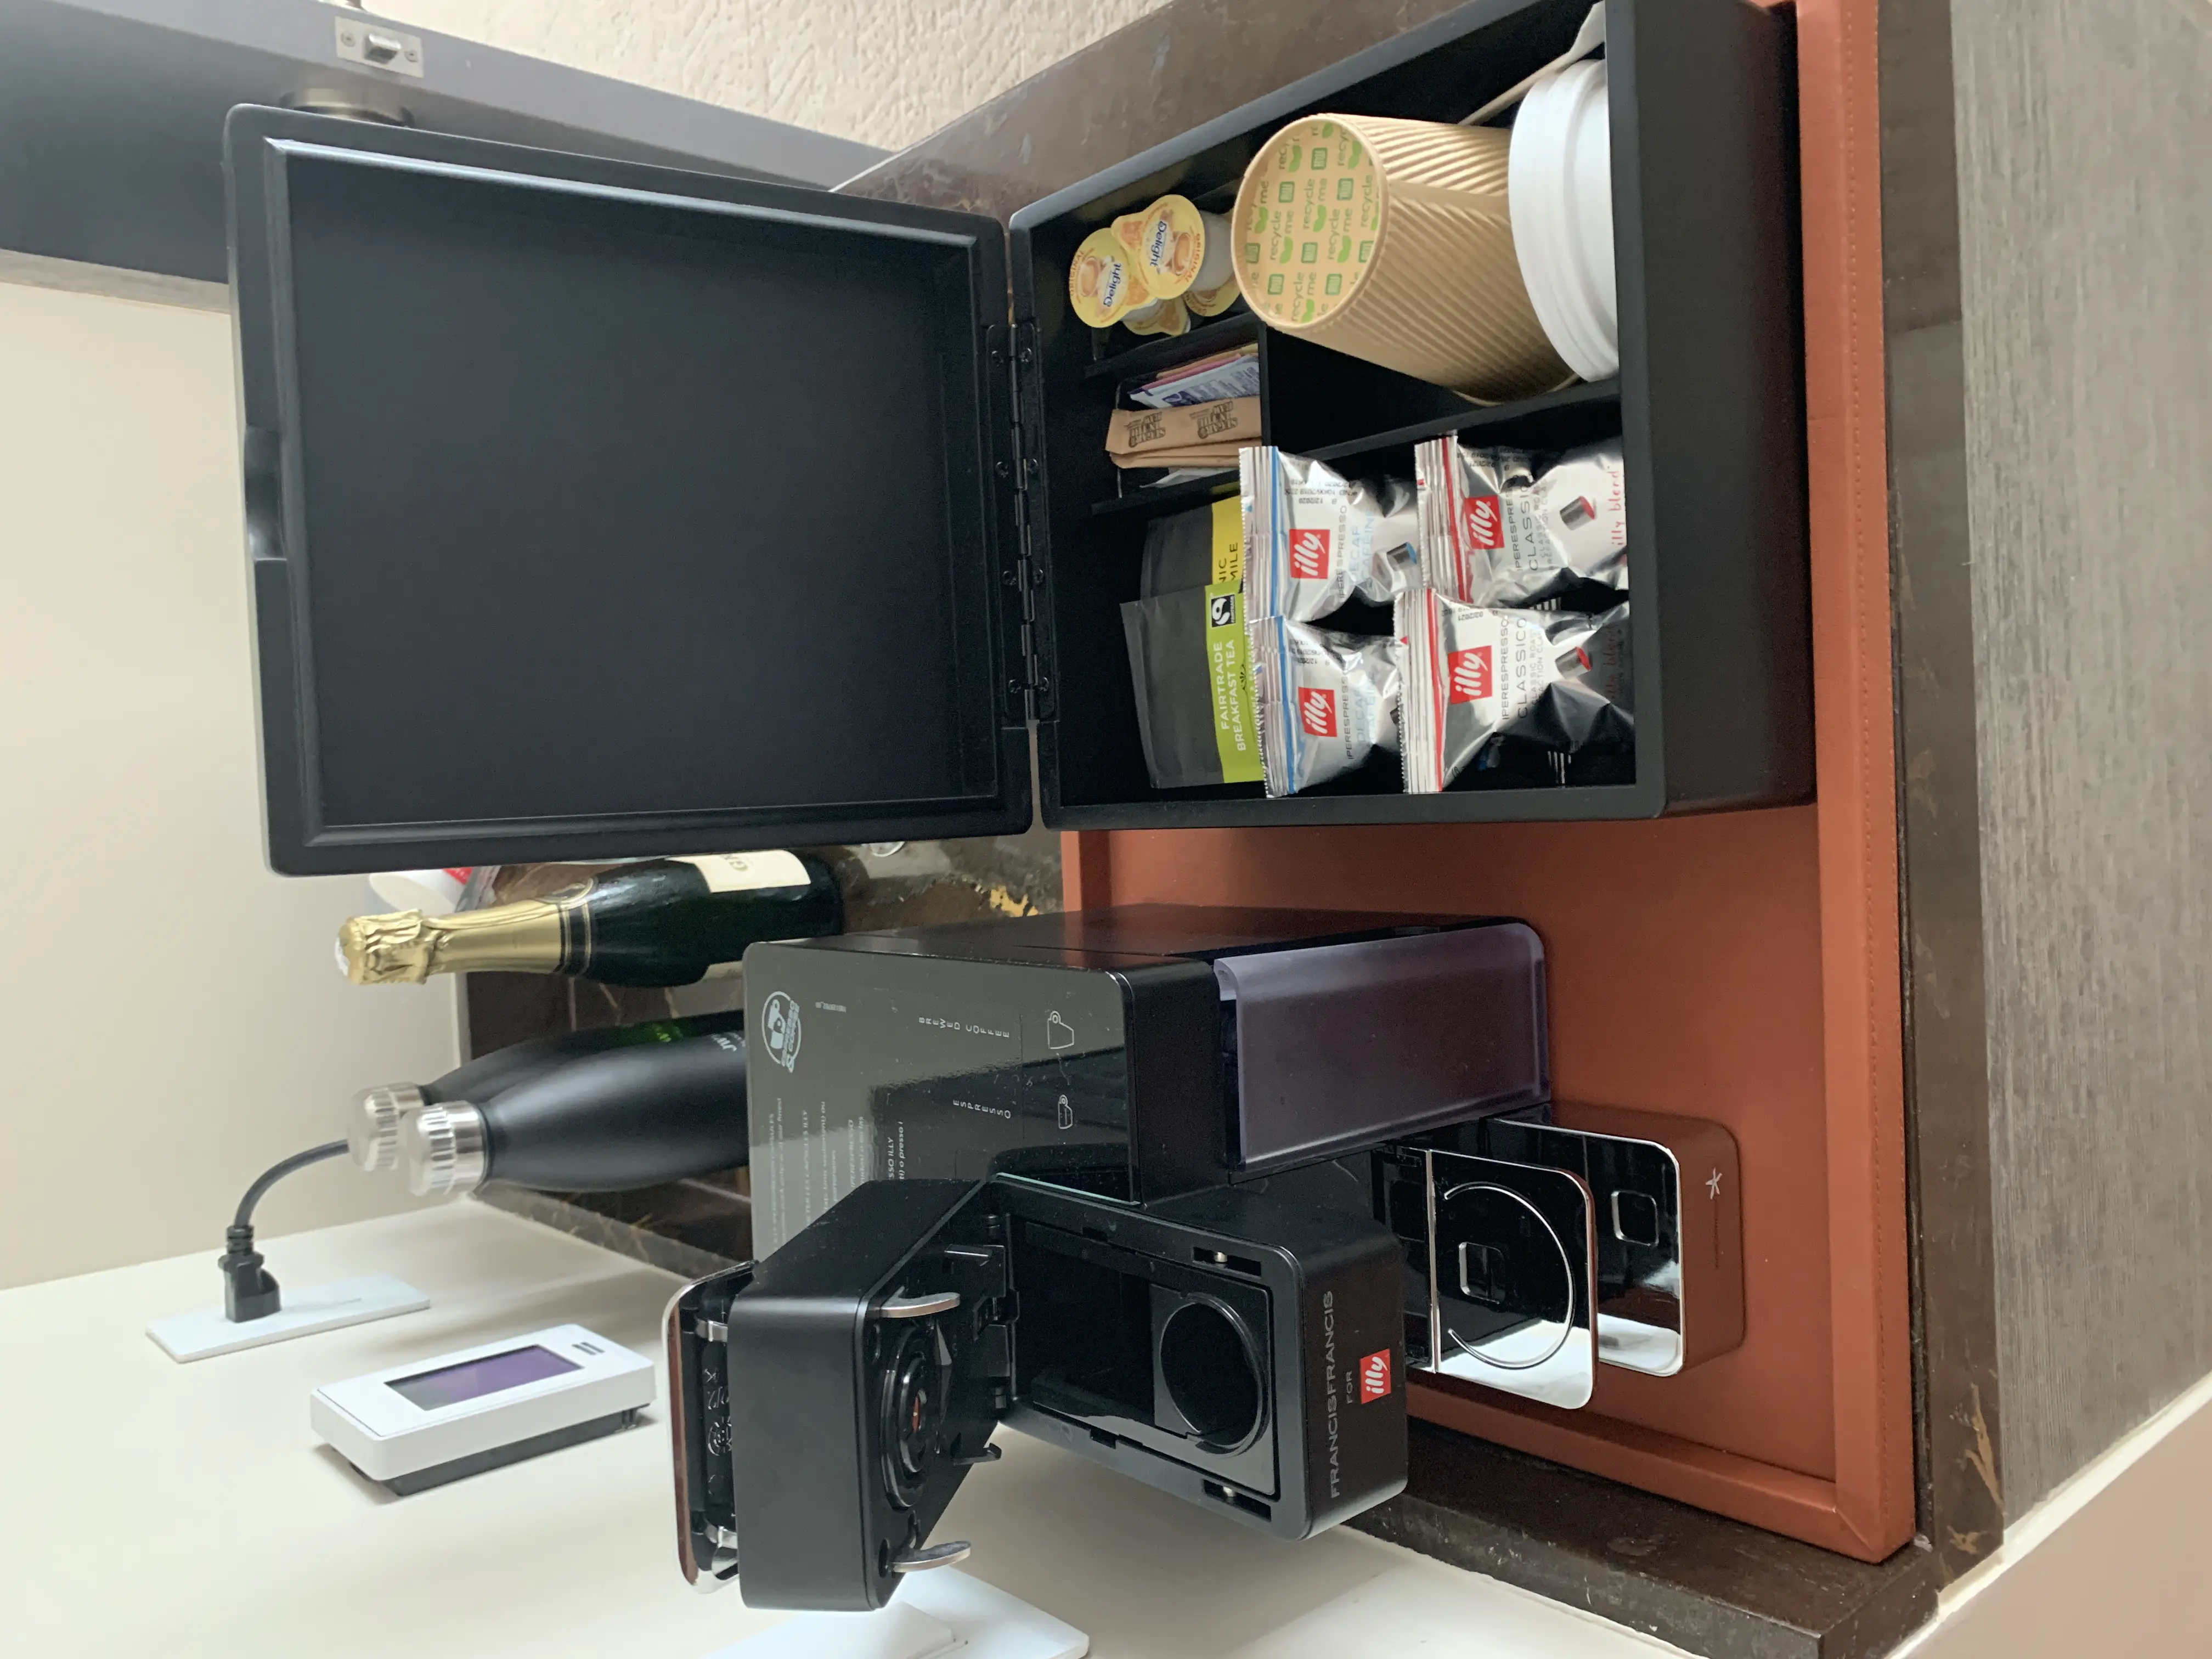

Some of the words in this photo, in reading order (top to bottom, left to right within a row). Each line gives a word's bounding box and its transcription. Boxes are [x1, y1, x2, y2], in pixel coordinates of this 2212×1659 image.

[1303, 179, 1315, 229] recycle
[1318, 178, 1328, 202] me
[1361, 175, 1373, 227] recycle
[1269, 211, 1282, 261] recycle
[1285, 210, 1294, 234] me
[1328, 209, 1340, 259] recycle
[1344, 208, 1353, 232] me
[1149, 221, 1167, 267] Delight
[1103, 263, 1121, 307] Delight
[1291, 272, 1304, 321] recycle
[1307, 272, 1317, 295] me
[1607, 471, 1622, 511] blend
[1469, 499, 1498, 546] illy
[1611, 521, 1624, 546] illy
[1294, 532, 1326, 576] illy
[1225, 639, 1235, 667] TEA
[1453, 652, 1489, 696] illy
[1500, 618, 1510, 720] IPERESPRESSO
[1515, 618, 1528, 719] CLASSICO
[1213, 641, 1230, 730] FAIRTRADE
[1227, 673, 1246, 752] BREAKFAST
[1304, 691, 1333, 735] illy
[918, 1017, 961, 1030] BREWED
[965, 1023, 1010, 1038] COFFEE
[952, 1099, 1011, 1119] ESPRESSO
[1323, 1290, 1340, 1499] FRANCISFRANCIS
[1364, 1356, 1388, 1394] illy
